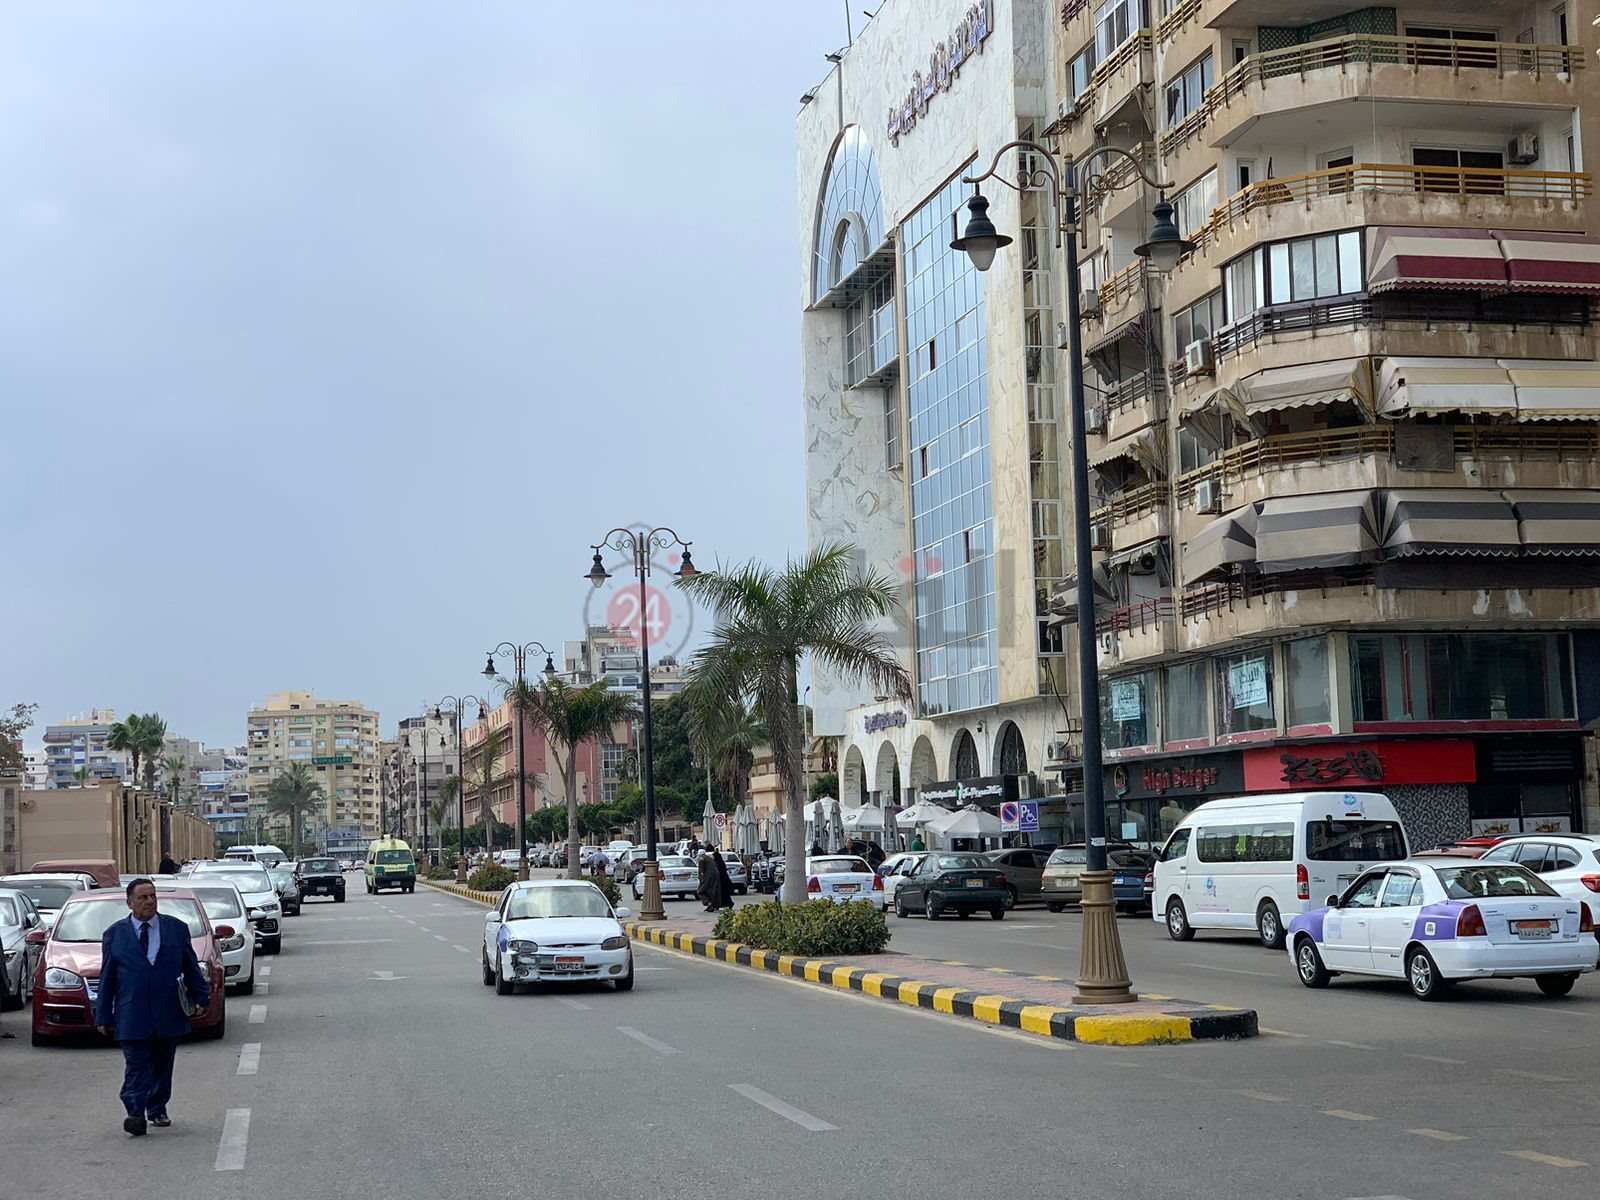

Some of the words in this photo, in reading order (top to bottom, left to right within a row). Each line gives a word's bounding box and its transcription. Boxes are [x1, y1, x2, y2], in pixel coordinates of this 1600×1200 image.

[1142, 768, 1170, 794] High
[1173, 767, 1217, 792] Burger
[1021, 804, 1028, 818] P
